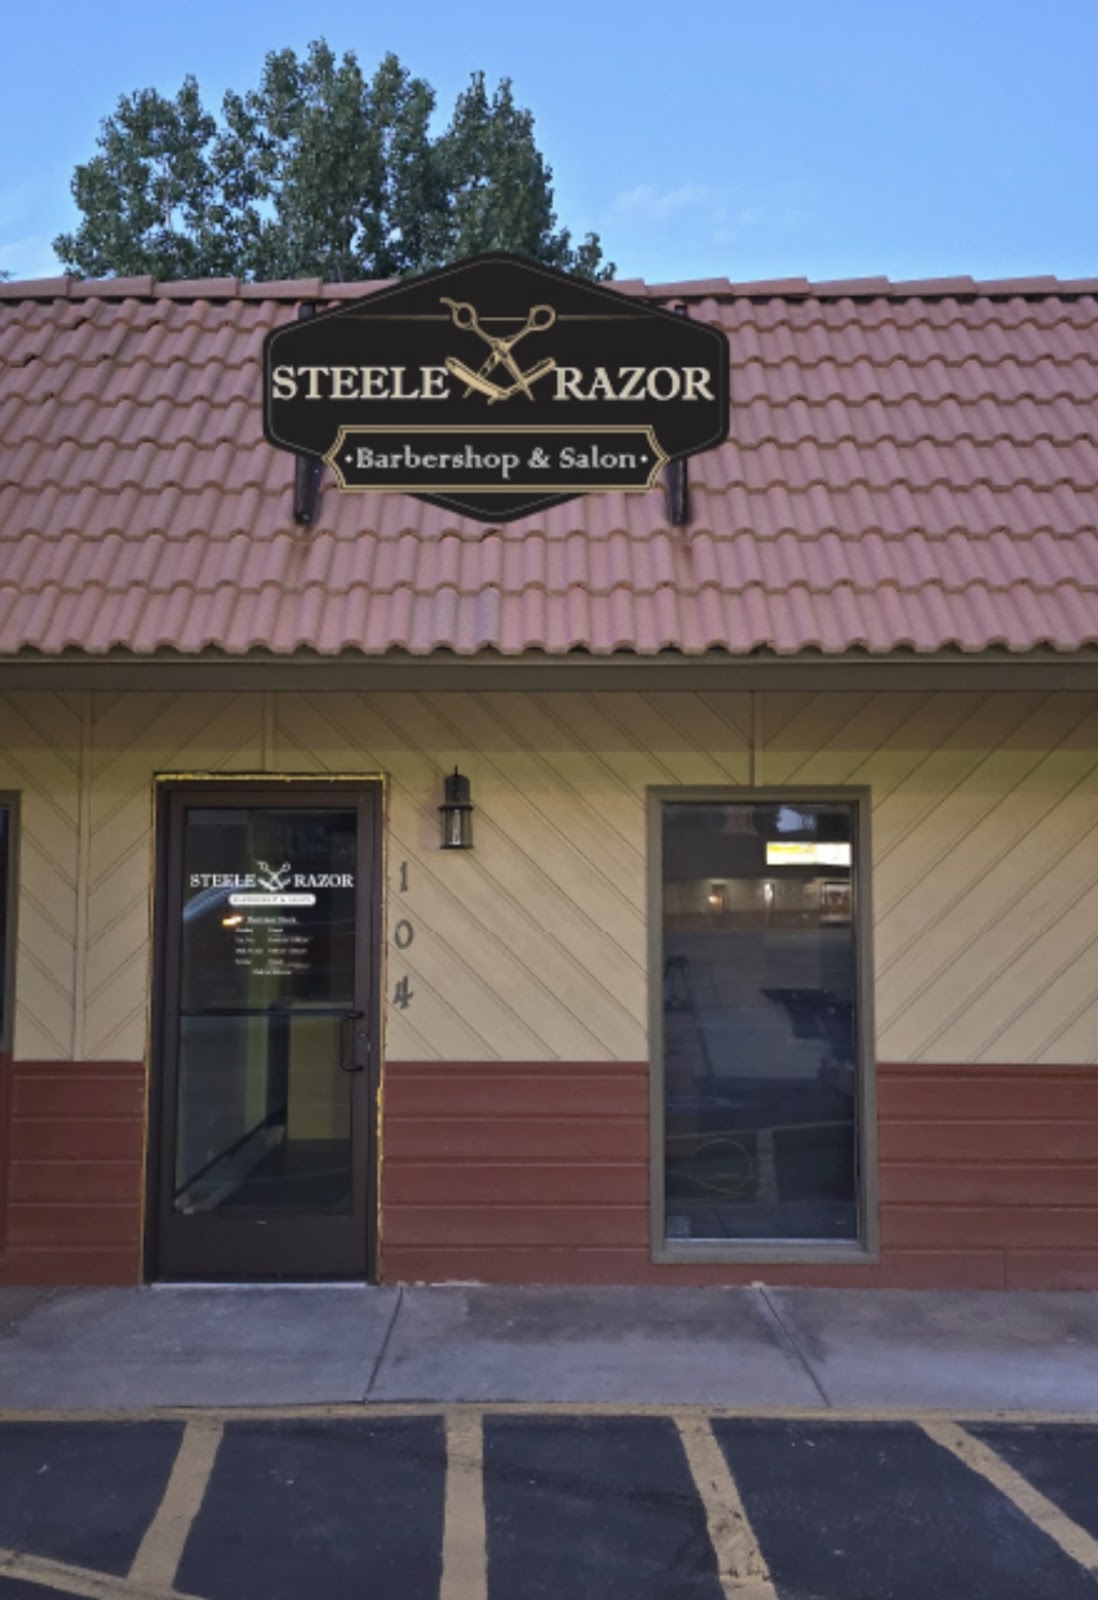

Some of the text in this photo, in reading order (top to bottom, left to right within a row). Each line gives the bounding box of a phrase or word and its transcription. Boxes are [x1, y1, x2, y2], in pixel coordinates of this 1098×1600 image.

[271, 364, 715, 402] STEELE RAZOR
[355, 444, 637, 480] Barbershop & Salon
[189, 873, 354, 888] STEELE RAZOR
